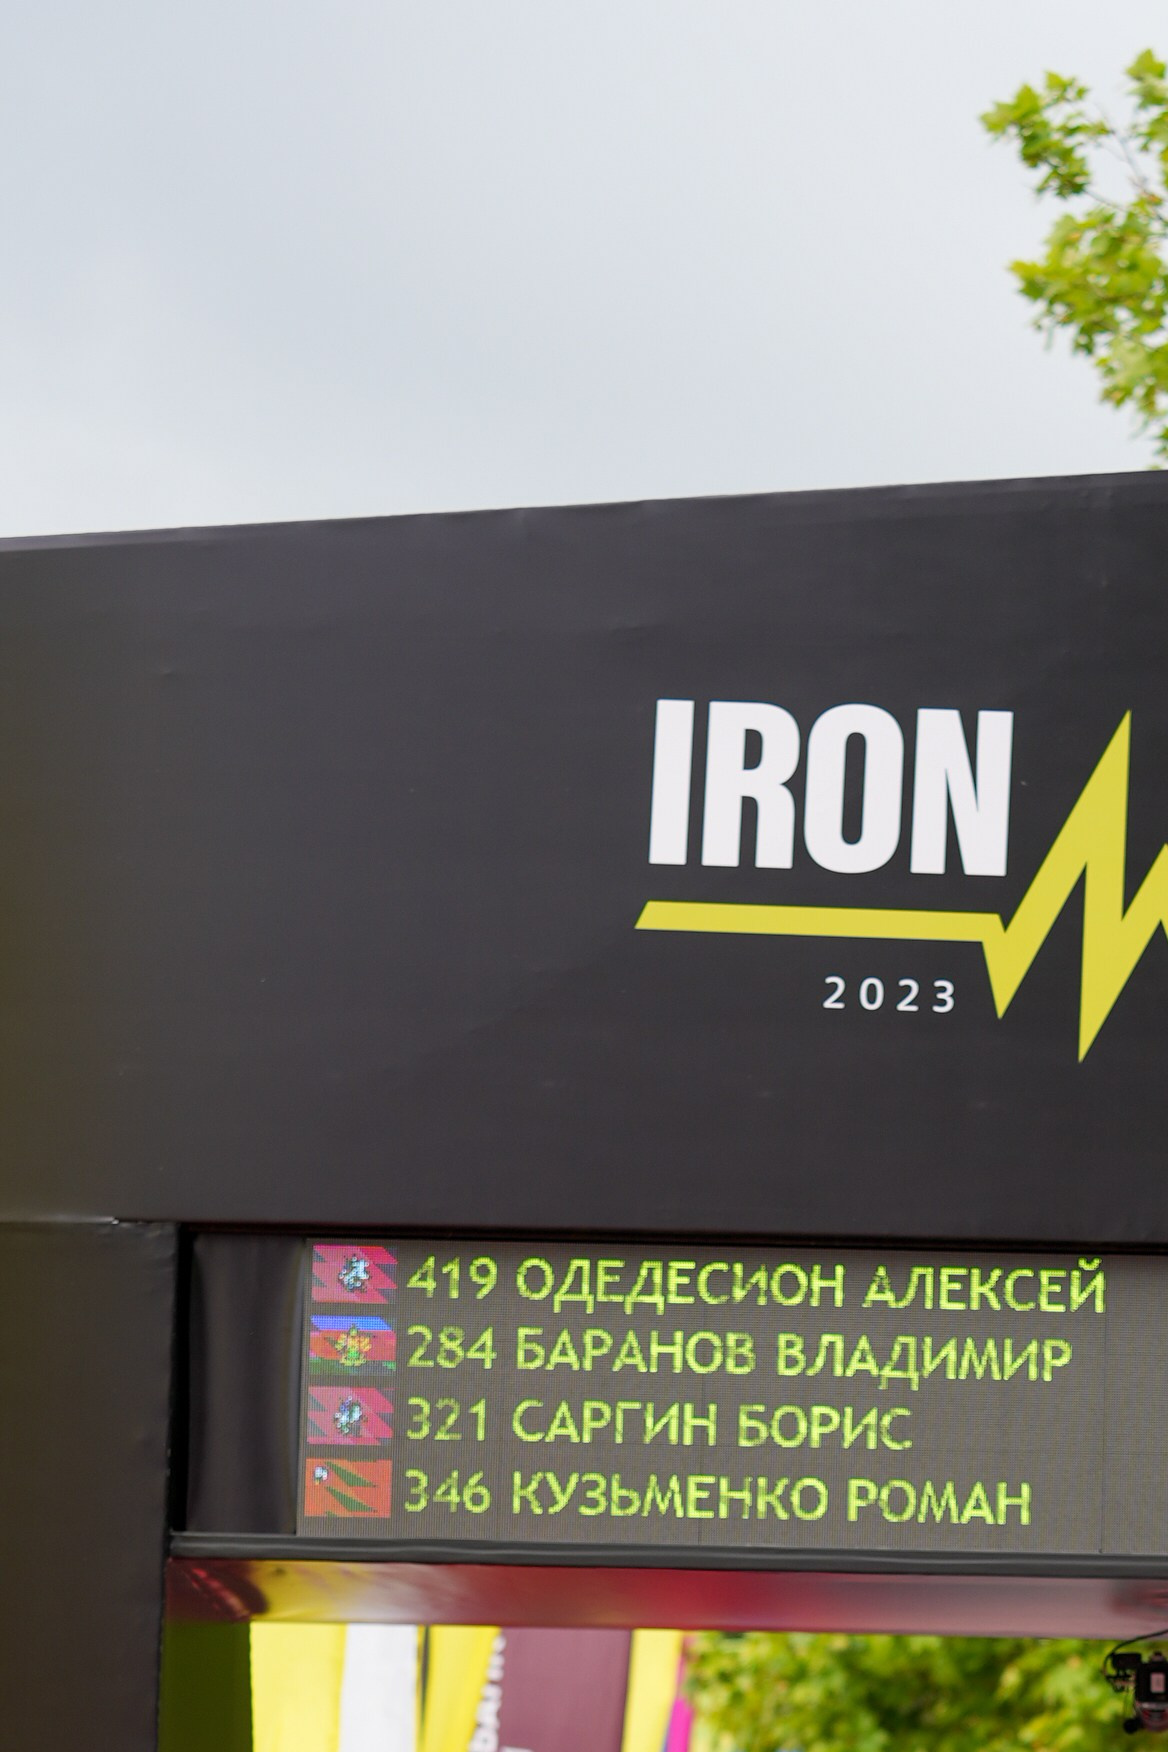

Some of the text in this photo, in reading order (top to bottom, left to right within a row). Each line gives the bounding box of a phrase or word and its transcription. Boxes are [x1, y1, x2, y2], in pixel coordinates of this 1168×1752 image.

[649, 699, 1013, 876] IRON
[822, 976, 955, 1013] 2023
[407, 1254, 497, 1298] 419
[516, 1256, 846, 1314] ОДЕДЕСИОН
[864, 1257, 1106, 1313] АЛЕКСЕЙ
[407, 1324, 497, 1369] 284
[516, 1326, 755, 1375] БАРАНОВ
[776, 1332, 1073, 1391] ВЛАДИМИР
[406, 1396, 486, 1440] 321
[512, 1398, 717, 1446] САРГИН
[737, 1403, 913, 1450] БОРИС
[405, 1468, 491, 1514] 346
[512, 1472, 829, 1521] КУЗЬМЕНКО
[847, 1477, 1032, 1525] РОМАН
